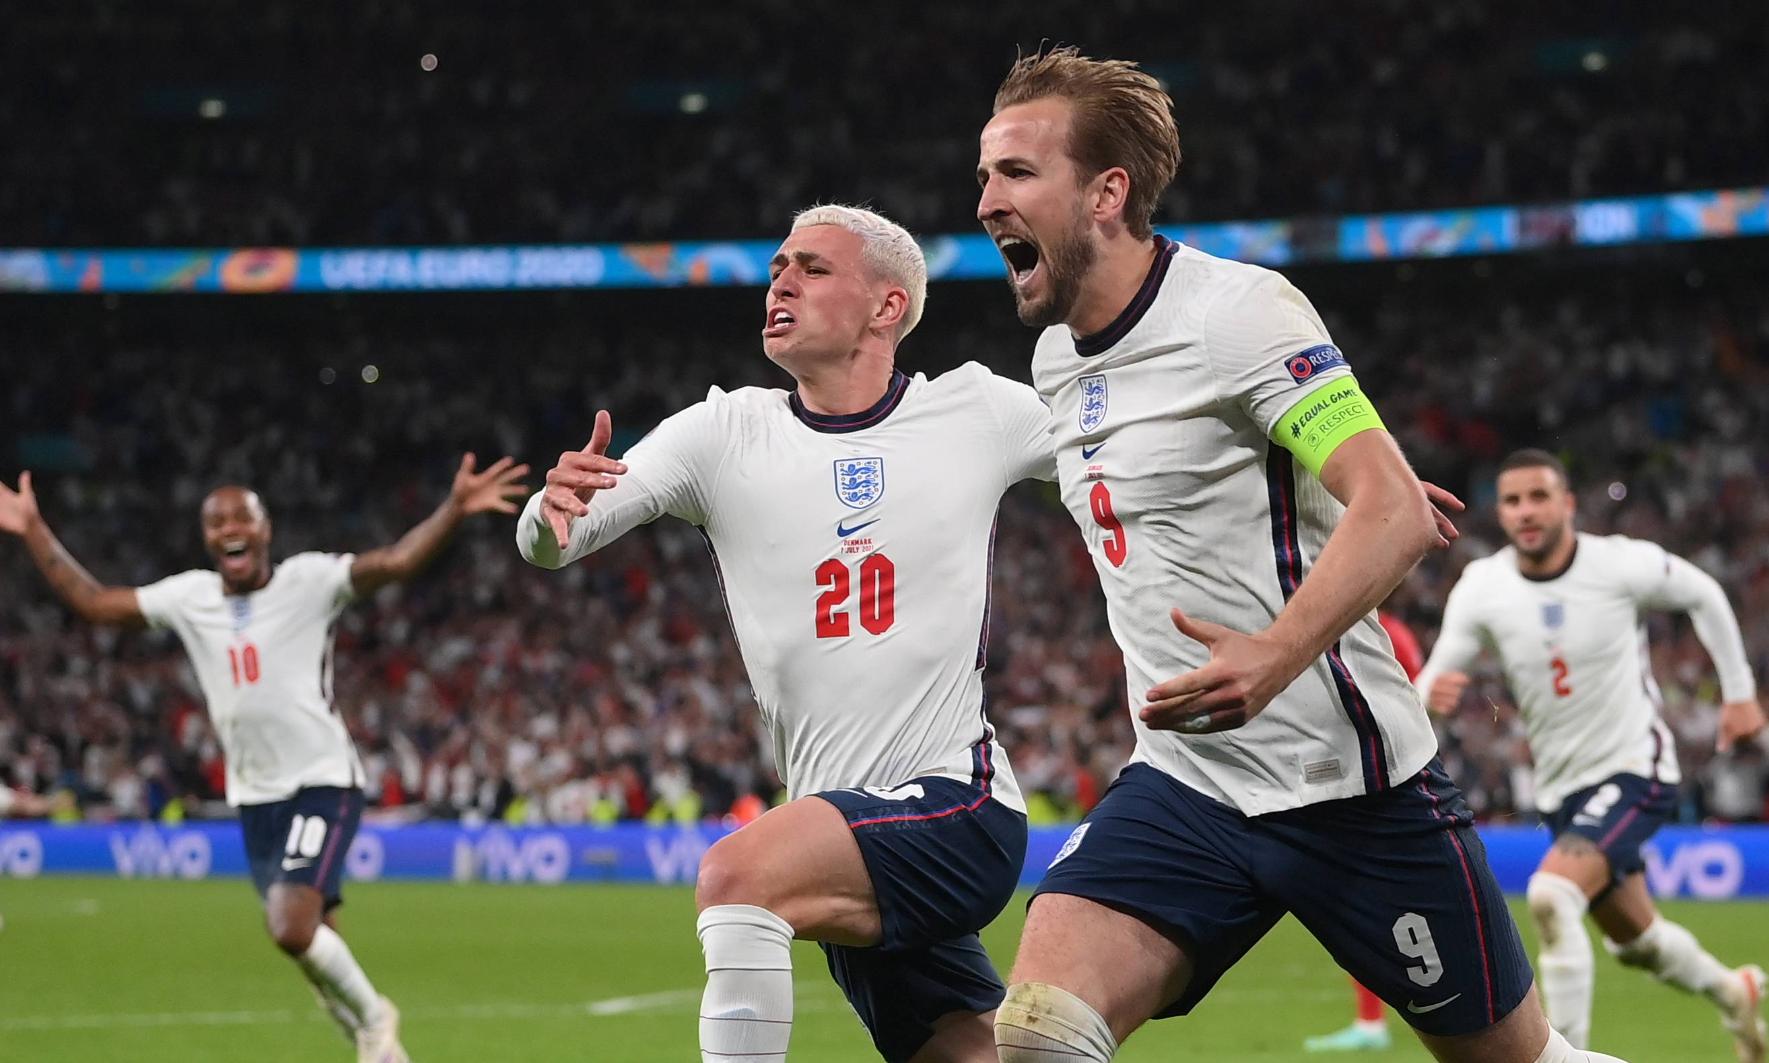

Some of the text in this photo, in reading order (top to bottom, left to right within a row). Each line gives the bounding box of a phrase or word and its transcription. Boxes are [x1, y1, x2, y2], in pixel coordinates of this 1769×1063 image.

[1318, 404, 1366, 434] RESPECT
[1089, 481, 1127, 568] 9
[815, 553, 895, 638] 20
[228, 645, 260, 686] 10
[1550, 658, 1572, 697] 2
[1584, 784, 1622, 817] 2
[286, 814, 327, 858] 10
[1392, 912, 1444, 988] 9
